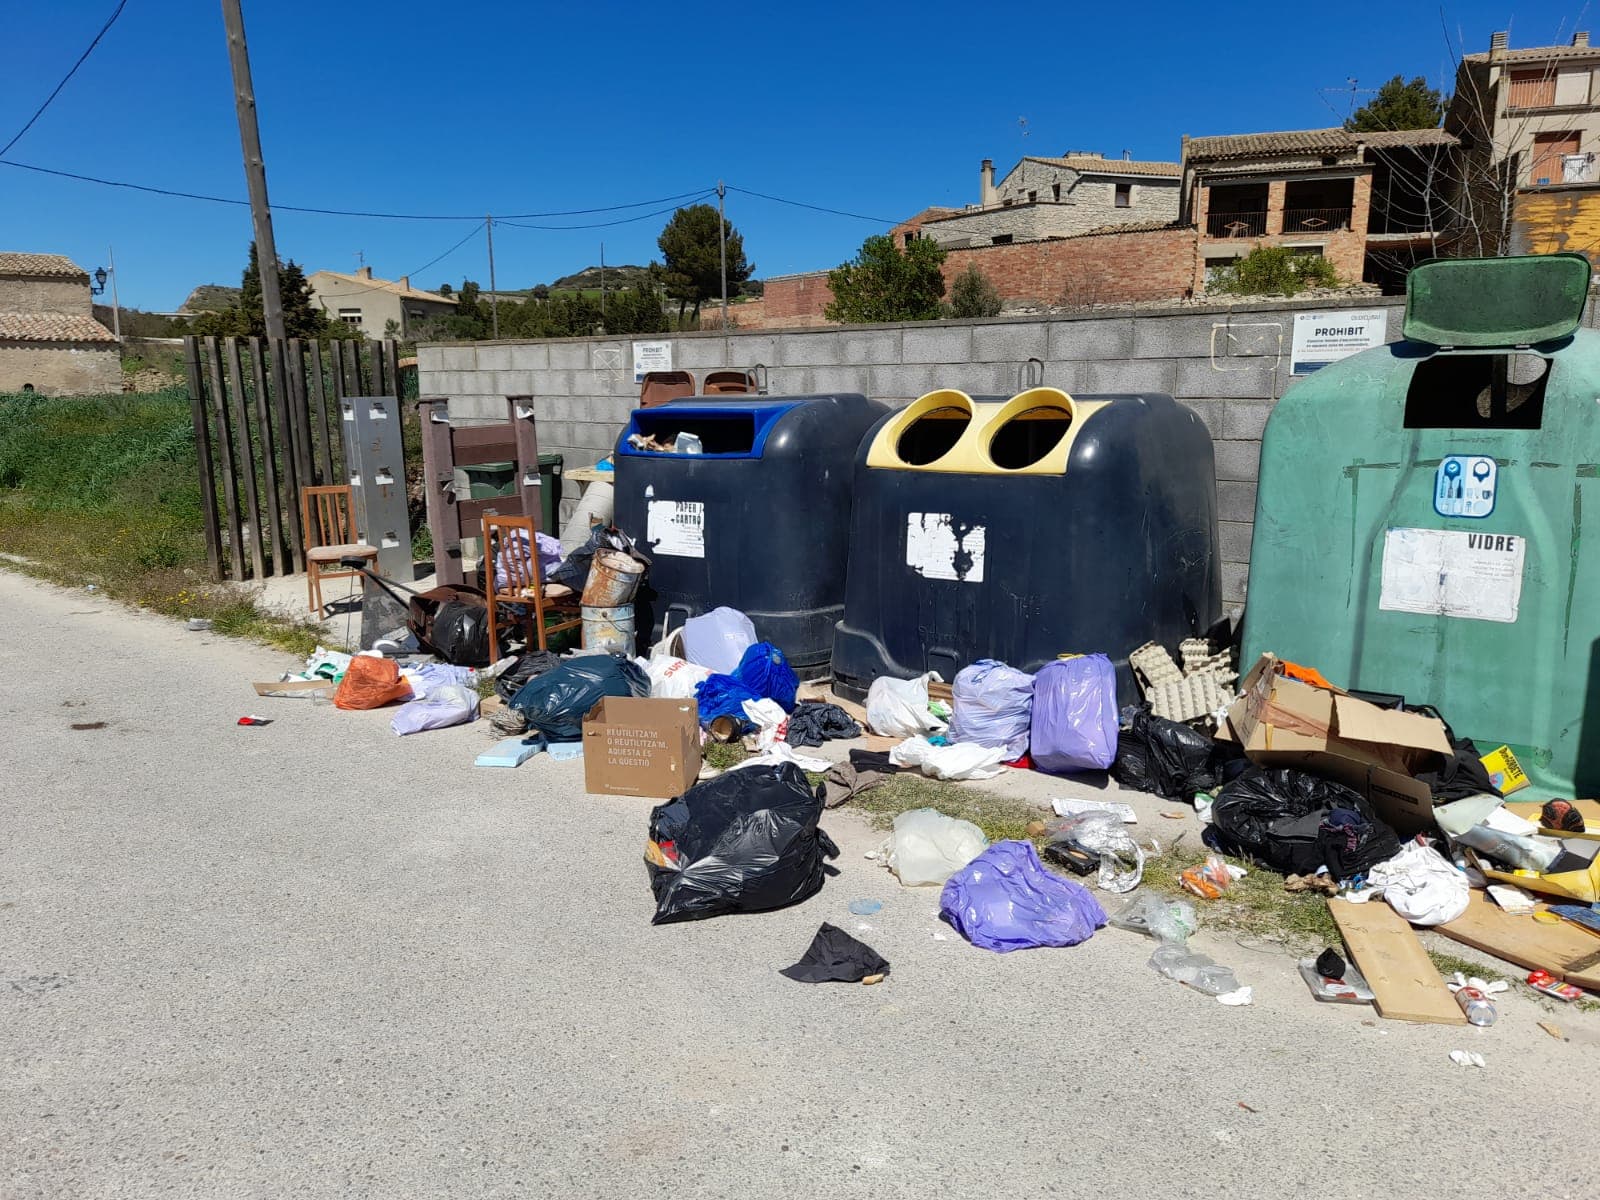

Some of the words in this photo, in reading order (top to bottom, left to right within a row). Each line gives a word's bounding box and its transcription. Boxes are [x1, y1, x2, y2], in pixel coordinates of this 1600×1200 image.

[1315, 326, 1365, 337] PROHIBIT
[676, 502, 699, 513] PAPER
[1467, 533, 1515, 552] VIDRE
[607, 737, 613, 745] O
[607, 748, 641, 757] AQUESTA
[608, 757, 617, 765] LA
